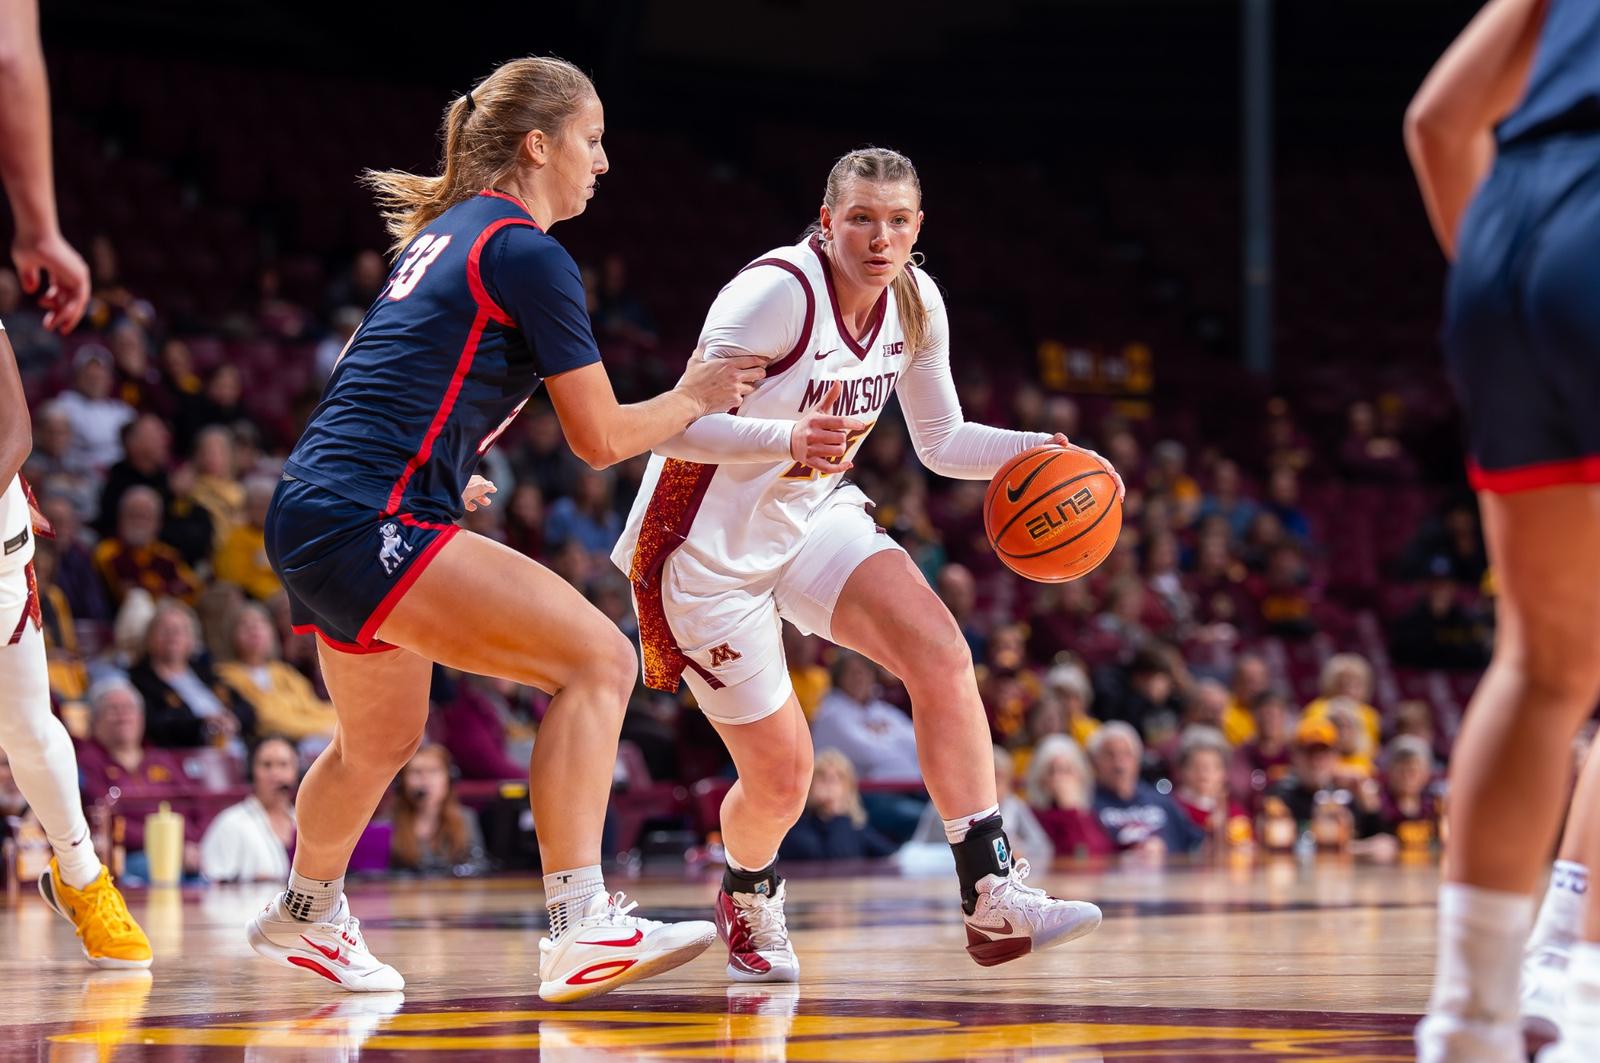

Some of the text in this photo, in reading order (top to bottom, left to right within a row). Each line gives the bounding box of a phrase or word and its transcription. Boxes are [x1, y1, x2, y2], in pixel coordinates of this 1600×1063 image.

[379, 233, 453, 302] 33
[798, 370, 900, 417] MNESOT
[1024, 486, 1096, 541] ELITE
[708, 641, 743, 668] M
